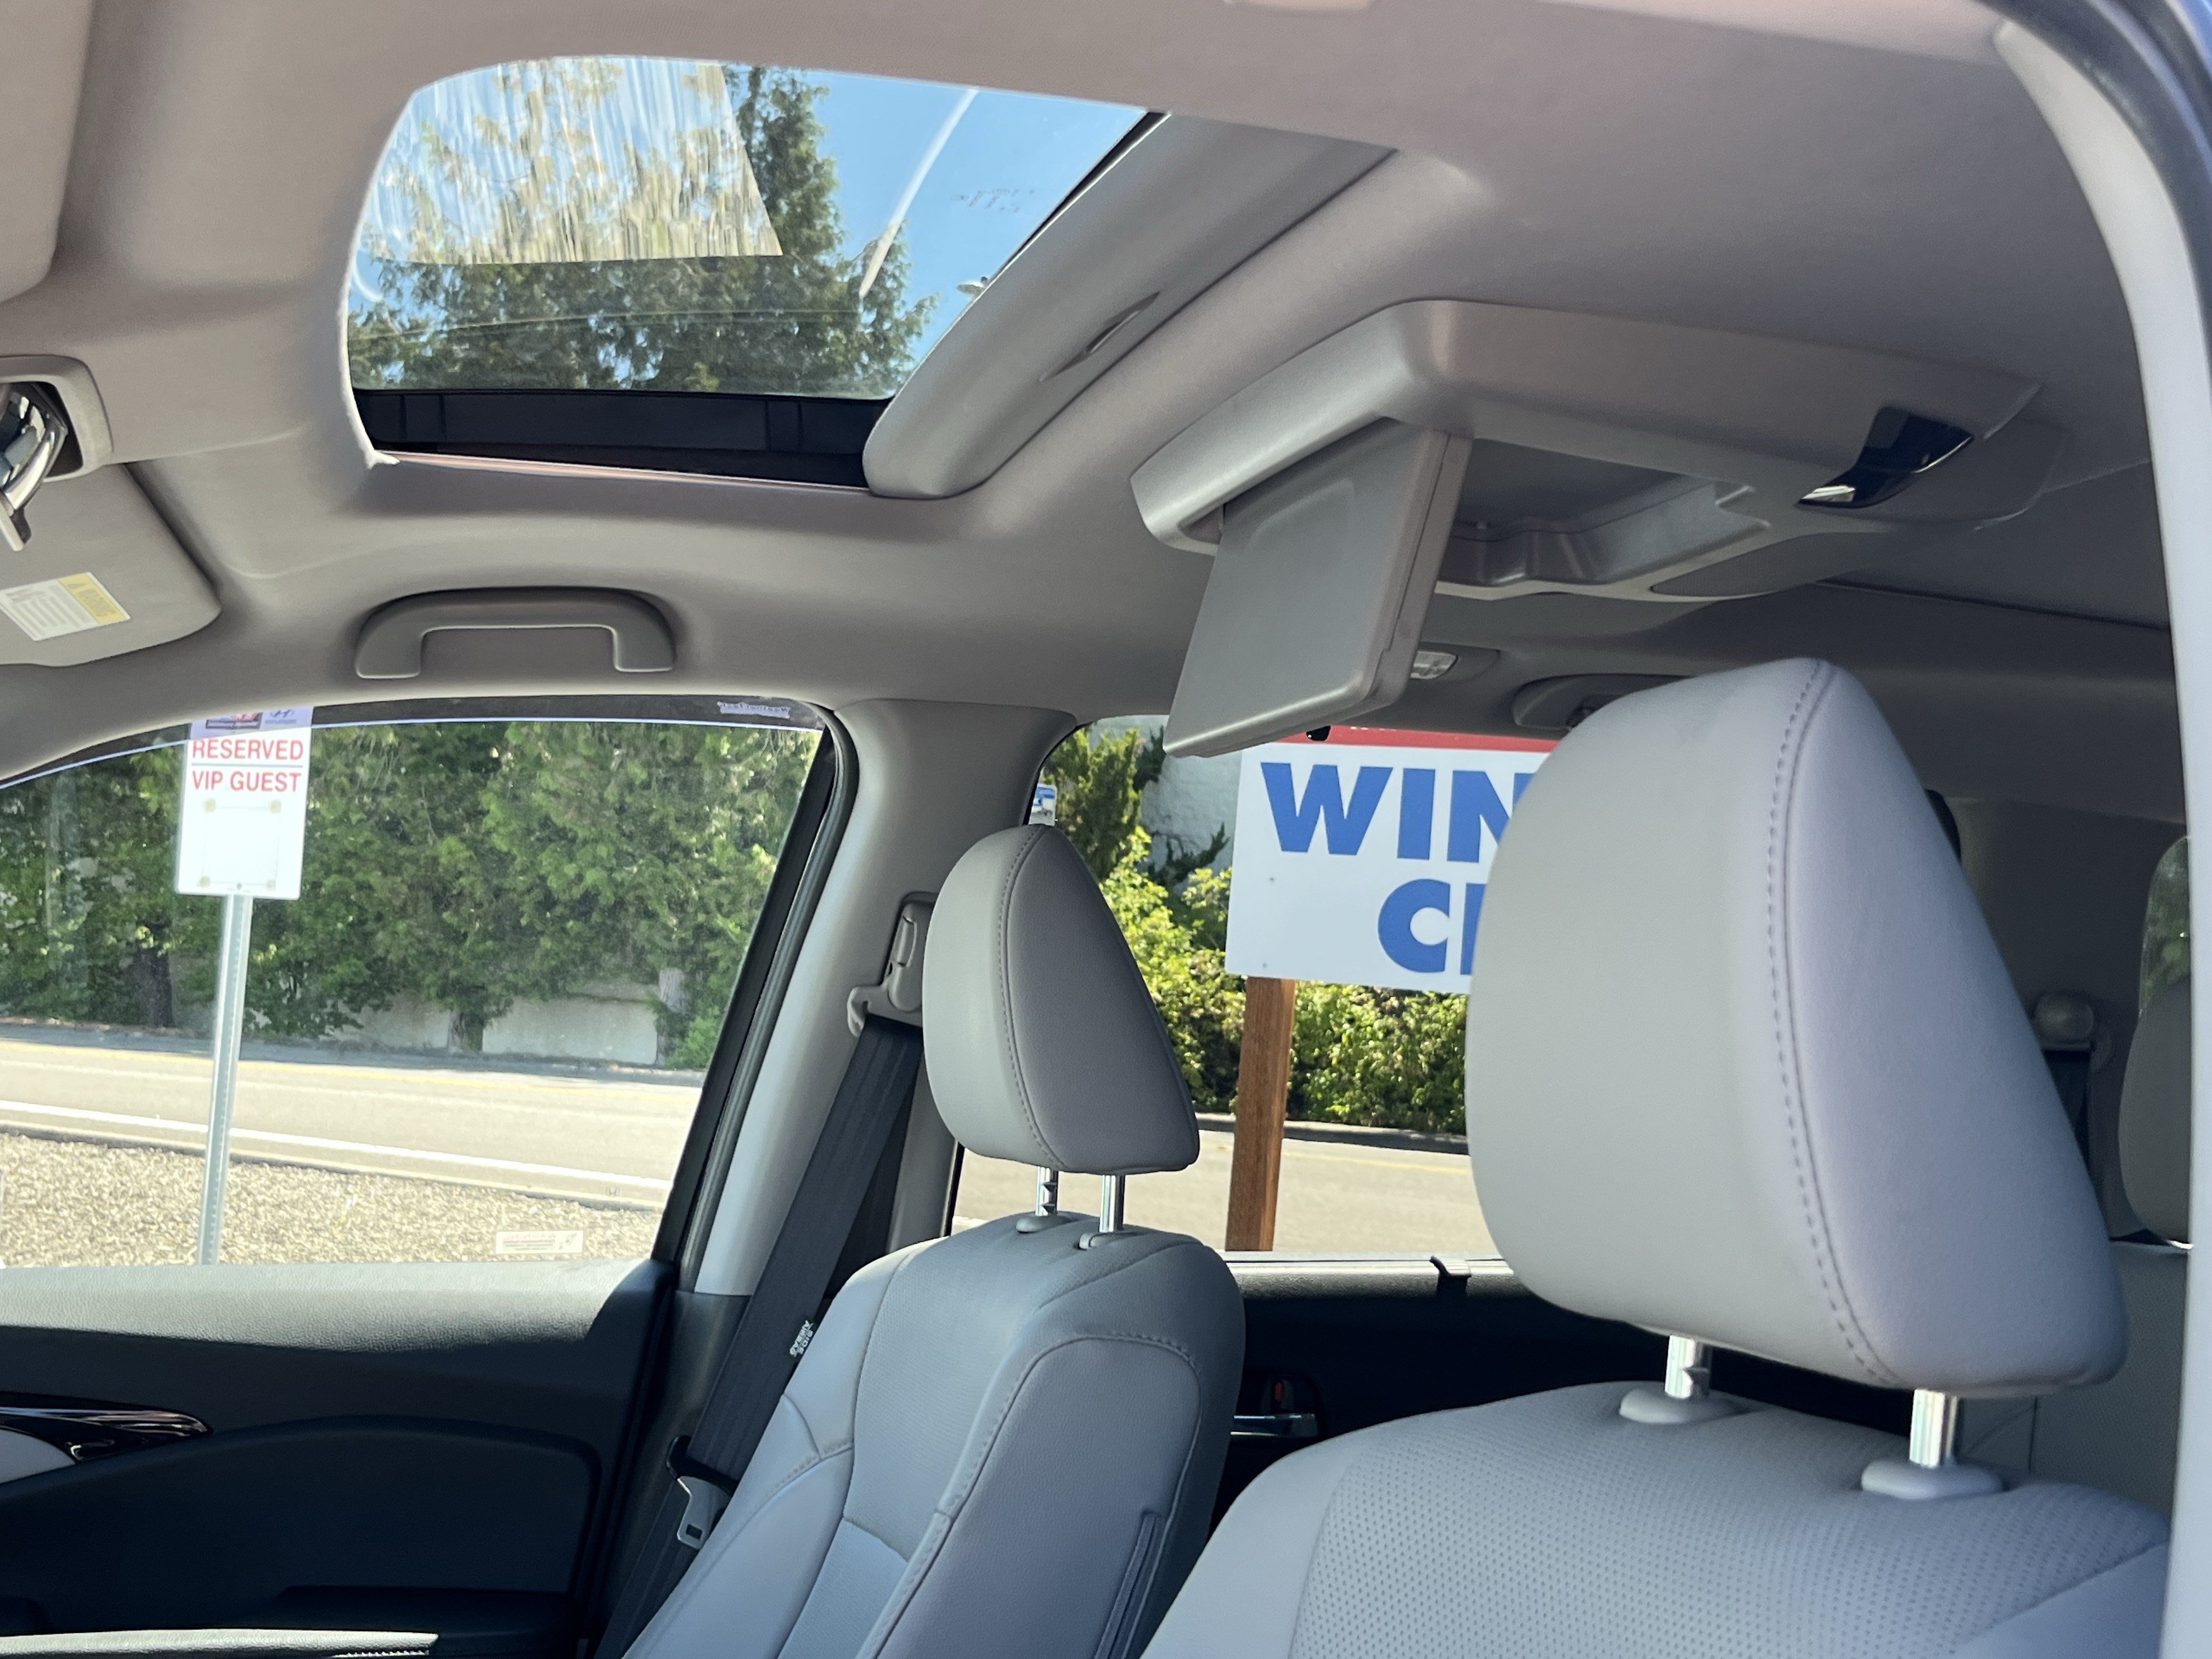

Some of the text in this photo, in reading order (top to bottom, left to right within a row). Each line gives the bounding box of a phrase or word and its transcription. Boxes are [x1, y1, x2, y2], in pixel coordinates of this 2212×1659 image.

[193, 738, 303, 760] RESERVED
[192, 770, 302, 792] VIP GUEST
